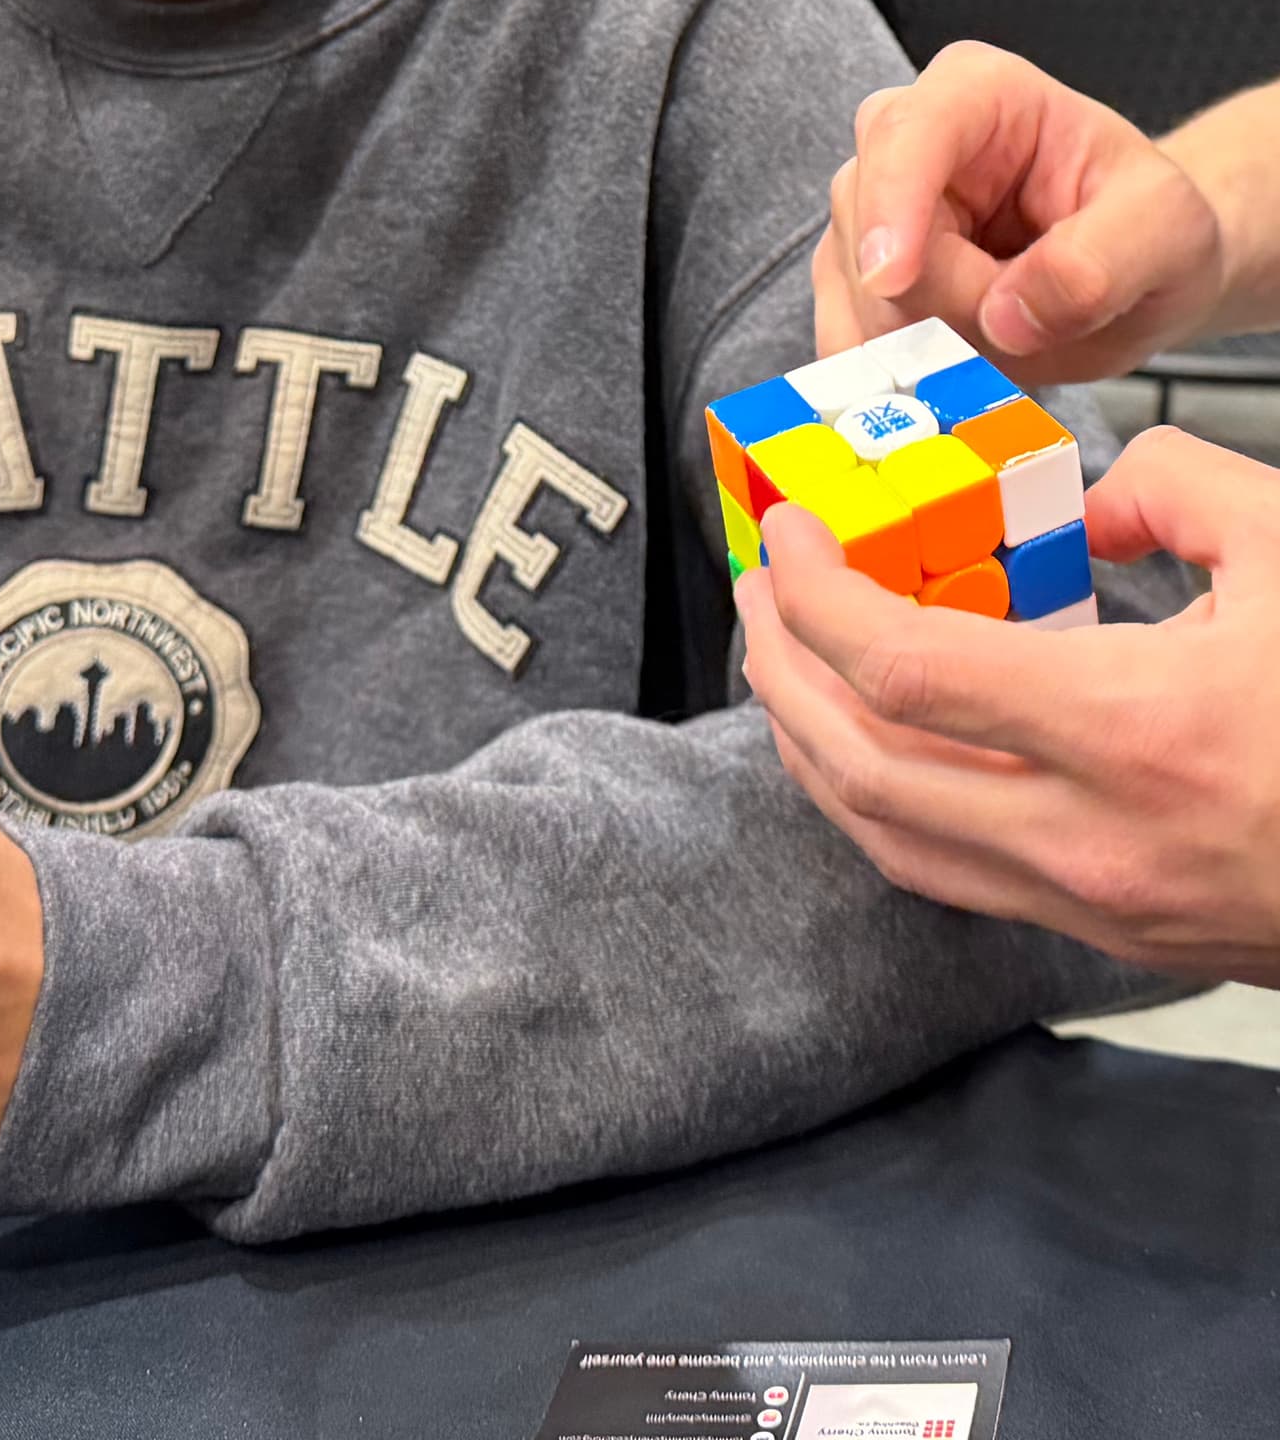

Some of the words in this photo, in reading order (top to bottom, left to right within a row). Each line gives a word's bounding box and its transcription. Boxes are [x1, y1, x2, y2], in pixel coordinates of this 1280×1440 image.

[72, 599, 209, 693] NORTHWEST
[646, 1354, 676, 1368] one
[678, 1353, 740, 1369] become
[743, 1353, 774, 1368] and
[870, 1354, 897, 1369] the
[900, 1353, 938, 1369] from
[664, 1389, 707, 1403] Cherry
[709, 1390, 757, 1404] Tommy
